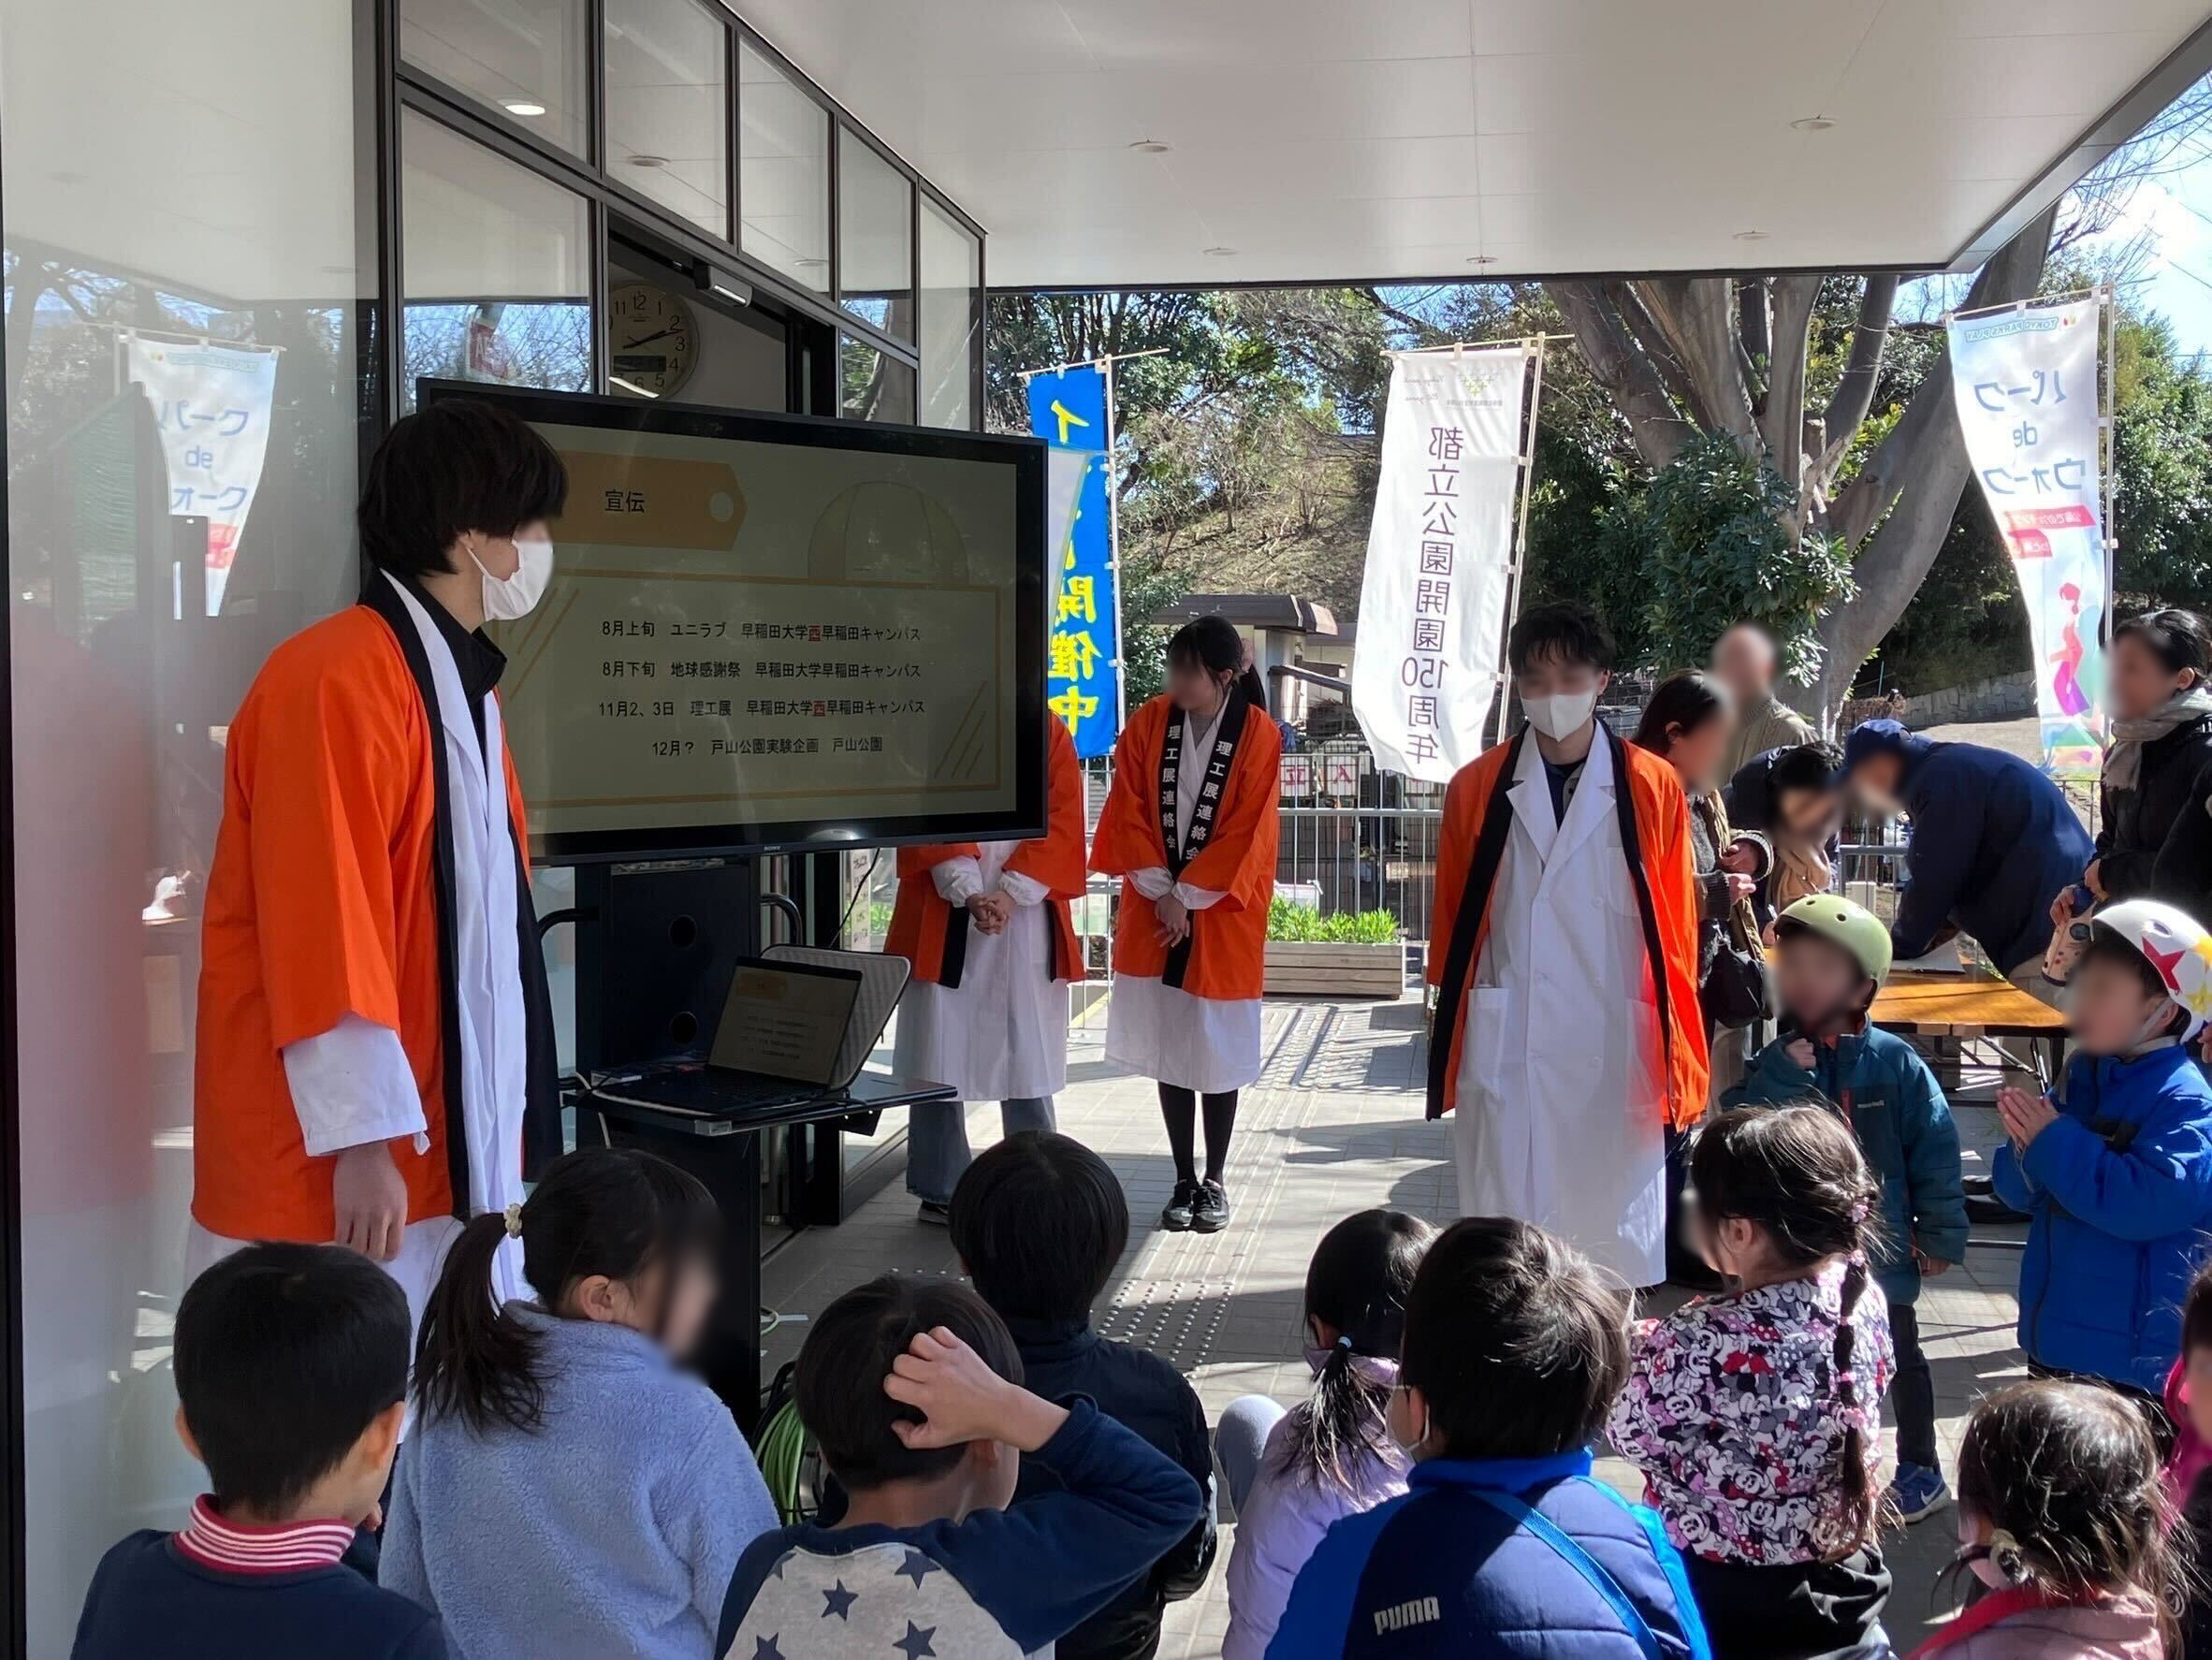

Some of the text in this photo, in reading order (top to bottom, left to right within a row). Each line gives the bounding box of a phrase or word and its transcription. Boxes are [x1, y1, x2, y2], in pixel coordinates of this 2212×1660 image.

[616, 300, 626, 315] 11
[633, 295, 647, 311] 12
[658, 301, 662, 315] 1
[670, 315, 680, 330] 2
[676, 336, 686, 352] 3
[669, 357, 679, 372] 4
[656, 374, 665, 387] 5
[185, 445, 213, 468] de
[605, 488, 645, 513] 宣伝
[602, 620, 655, 637] 8月上旬
[741, 623, 922, 642] 早稲田大学西早稲田キャンパス
[603, 661, 922, 678] 8月下旬 地球感謝祭 早稲田大学早稲田キャンパス
[691, 700, 732, 717] 理工展
[746, 700, 925, 718] 早稲田大学西早稲田キャンパス
[710, 737, 819, 755] 戸山公園実験企画
[832, 736, 883, 753] 戸山公園
[1161, 724, 1182, 849] 理工展連絡会
[1186, 740, 1233, 861] 理工展連絡会
[1374, 1595, 1440, 1636] PUMA
